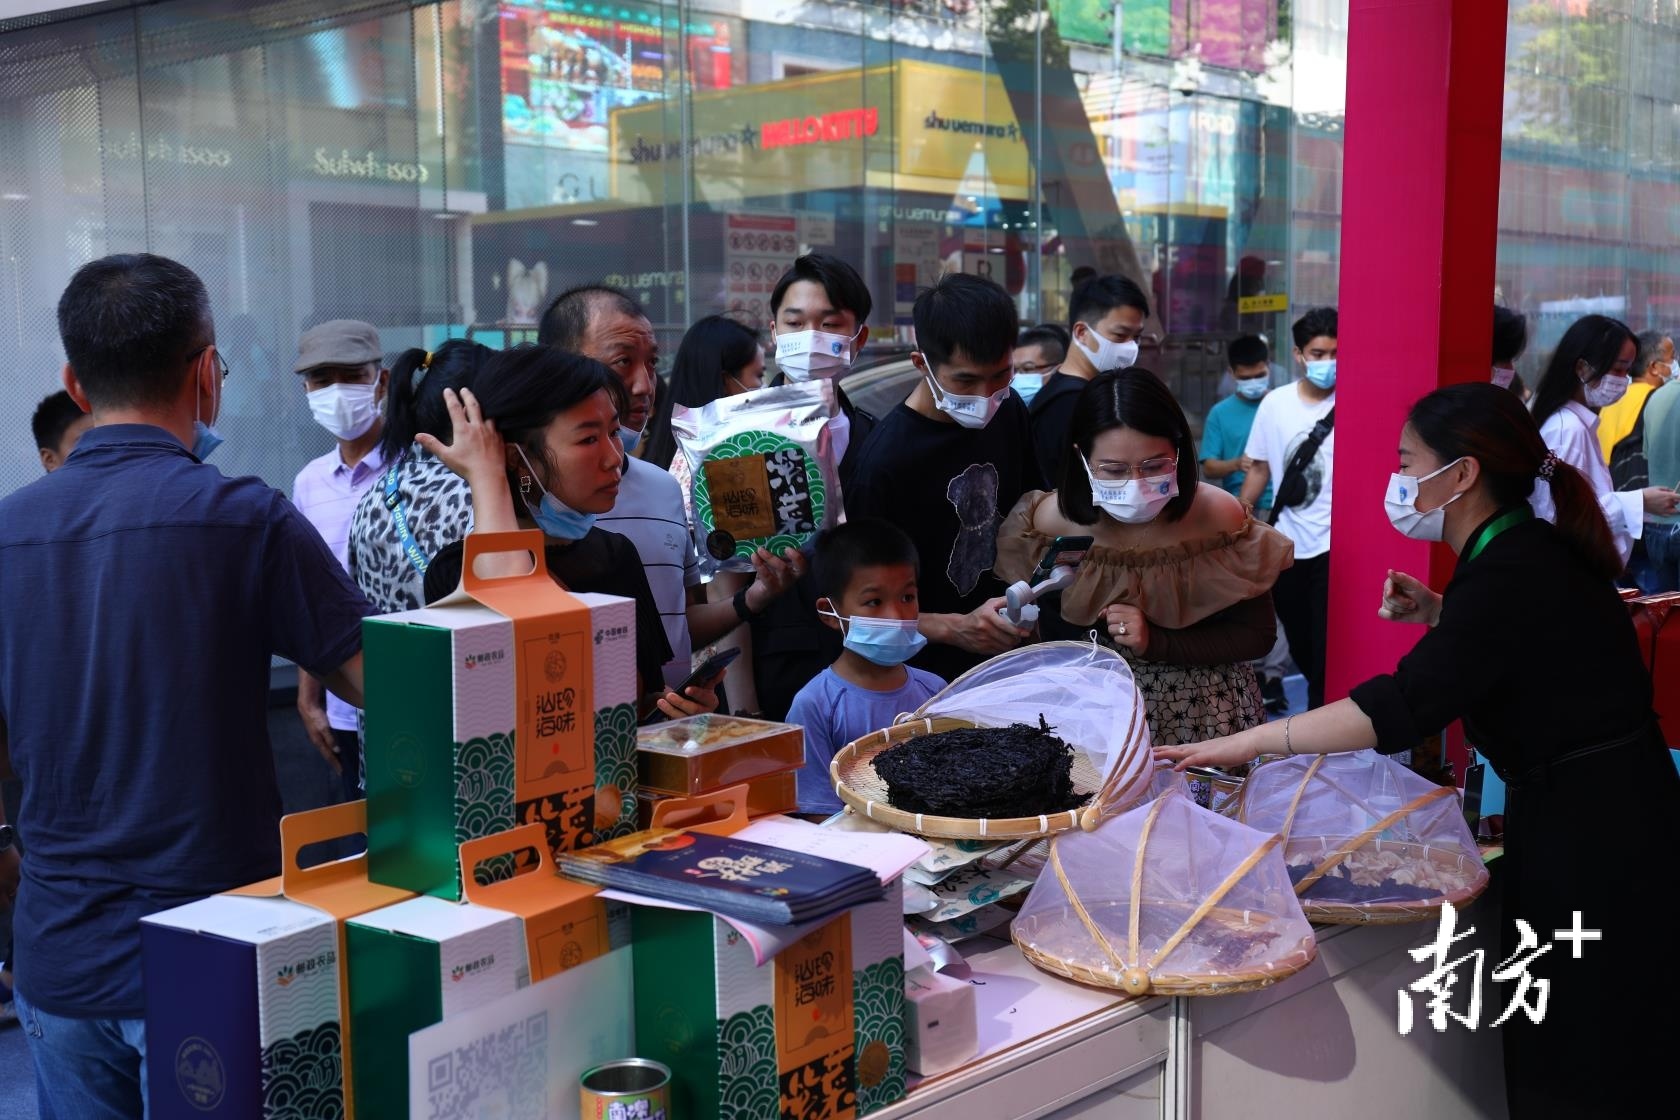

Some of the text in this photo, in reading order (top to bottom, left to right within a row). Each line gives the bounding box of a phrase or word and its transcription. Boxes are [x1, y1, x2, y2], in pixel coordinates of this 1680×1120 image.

[761, 117, 817, 150] HELLO
[818, 106, 878, 143] KITTY
[925, 109, 1006, 139] shu uemura
[536, 712, 576, 739] 海味
[795, 975, 835, 1008] 海味
